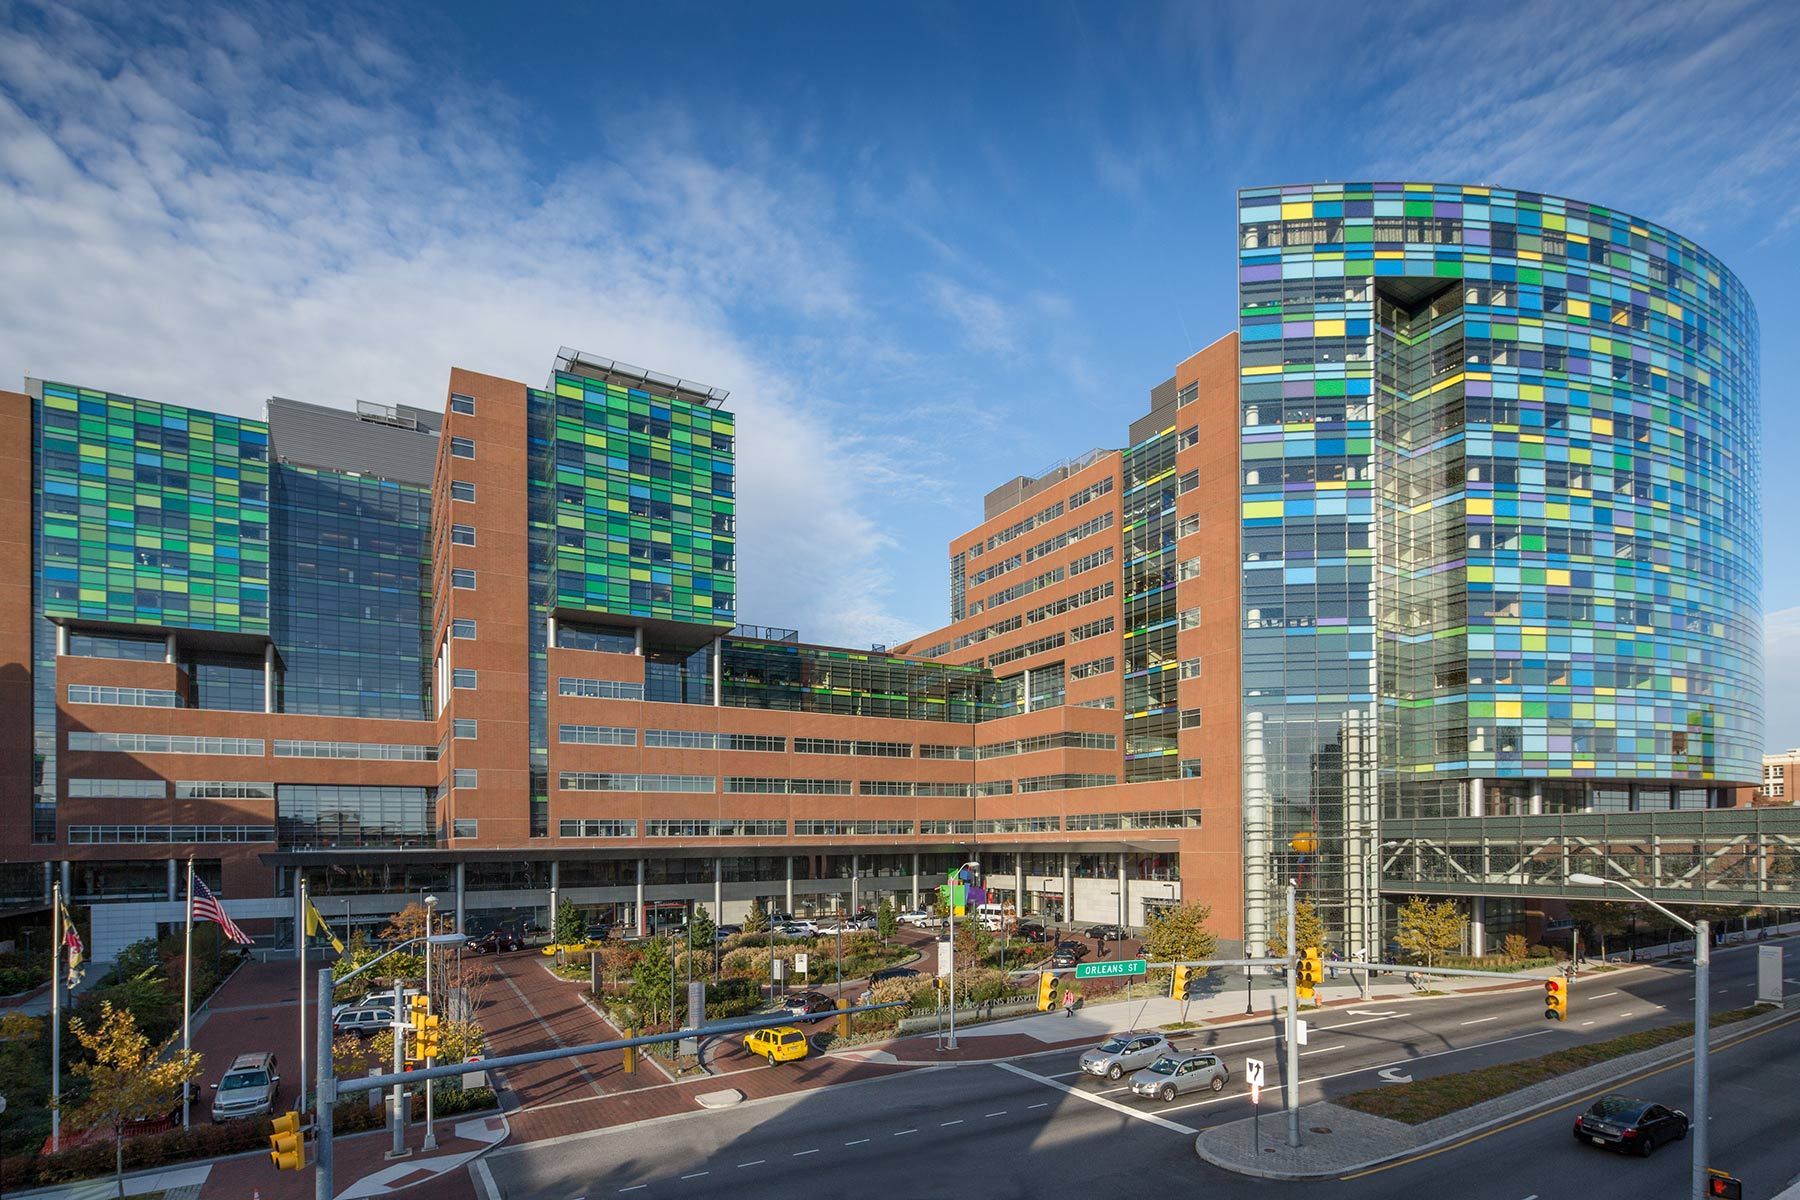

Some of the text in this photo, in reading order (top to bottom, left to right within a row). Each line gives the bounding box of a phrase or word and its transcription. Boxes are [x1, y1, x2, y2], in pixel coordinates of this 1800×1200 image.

[1085, 963, 1138, 975] ORLEANS ST
[911, 1006, 931, 1017] THE
[1006, 994, 1037, 1004] HOSPIT
